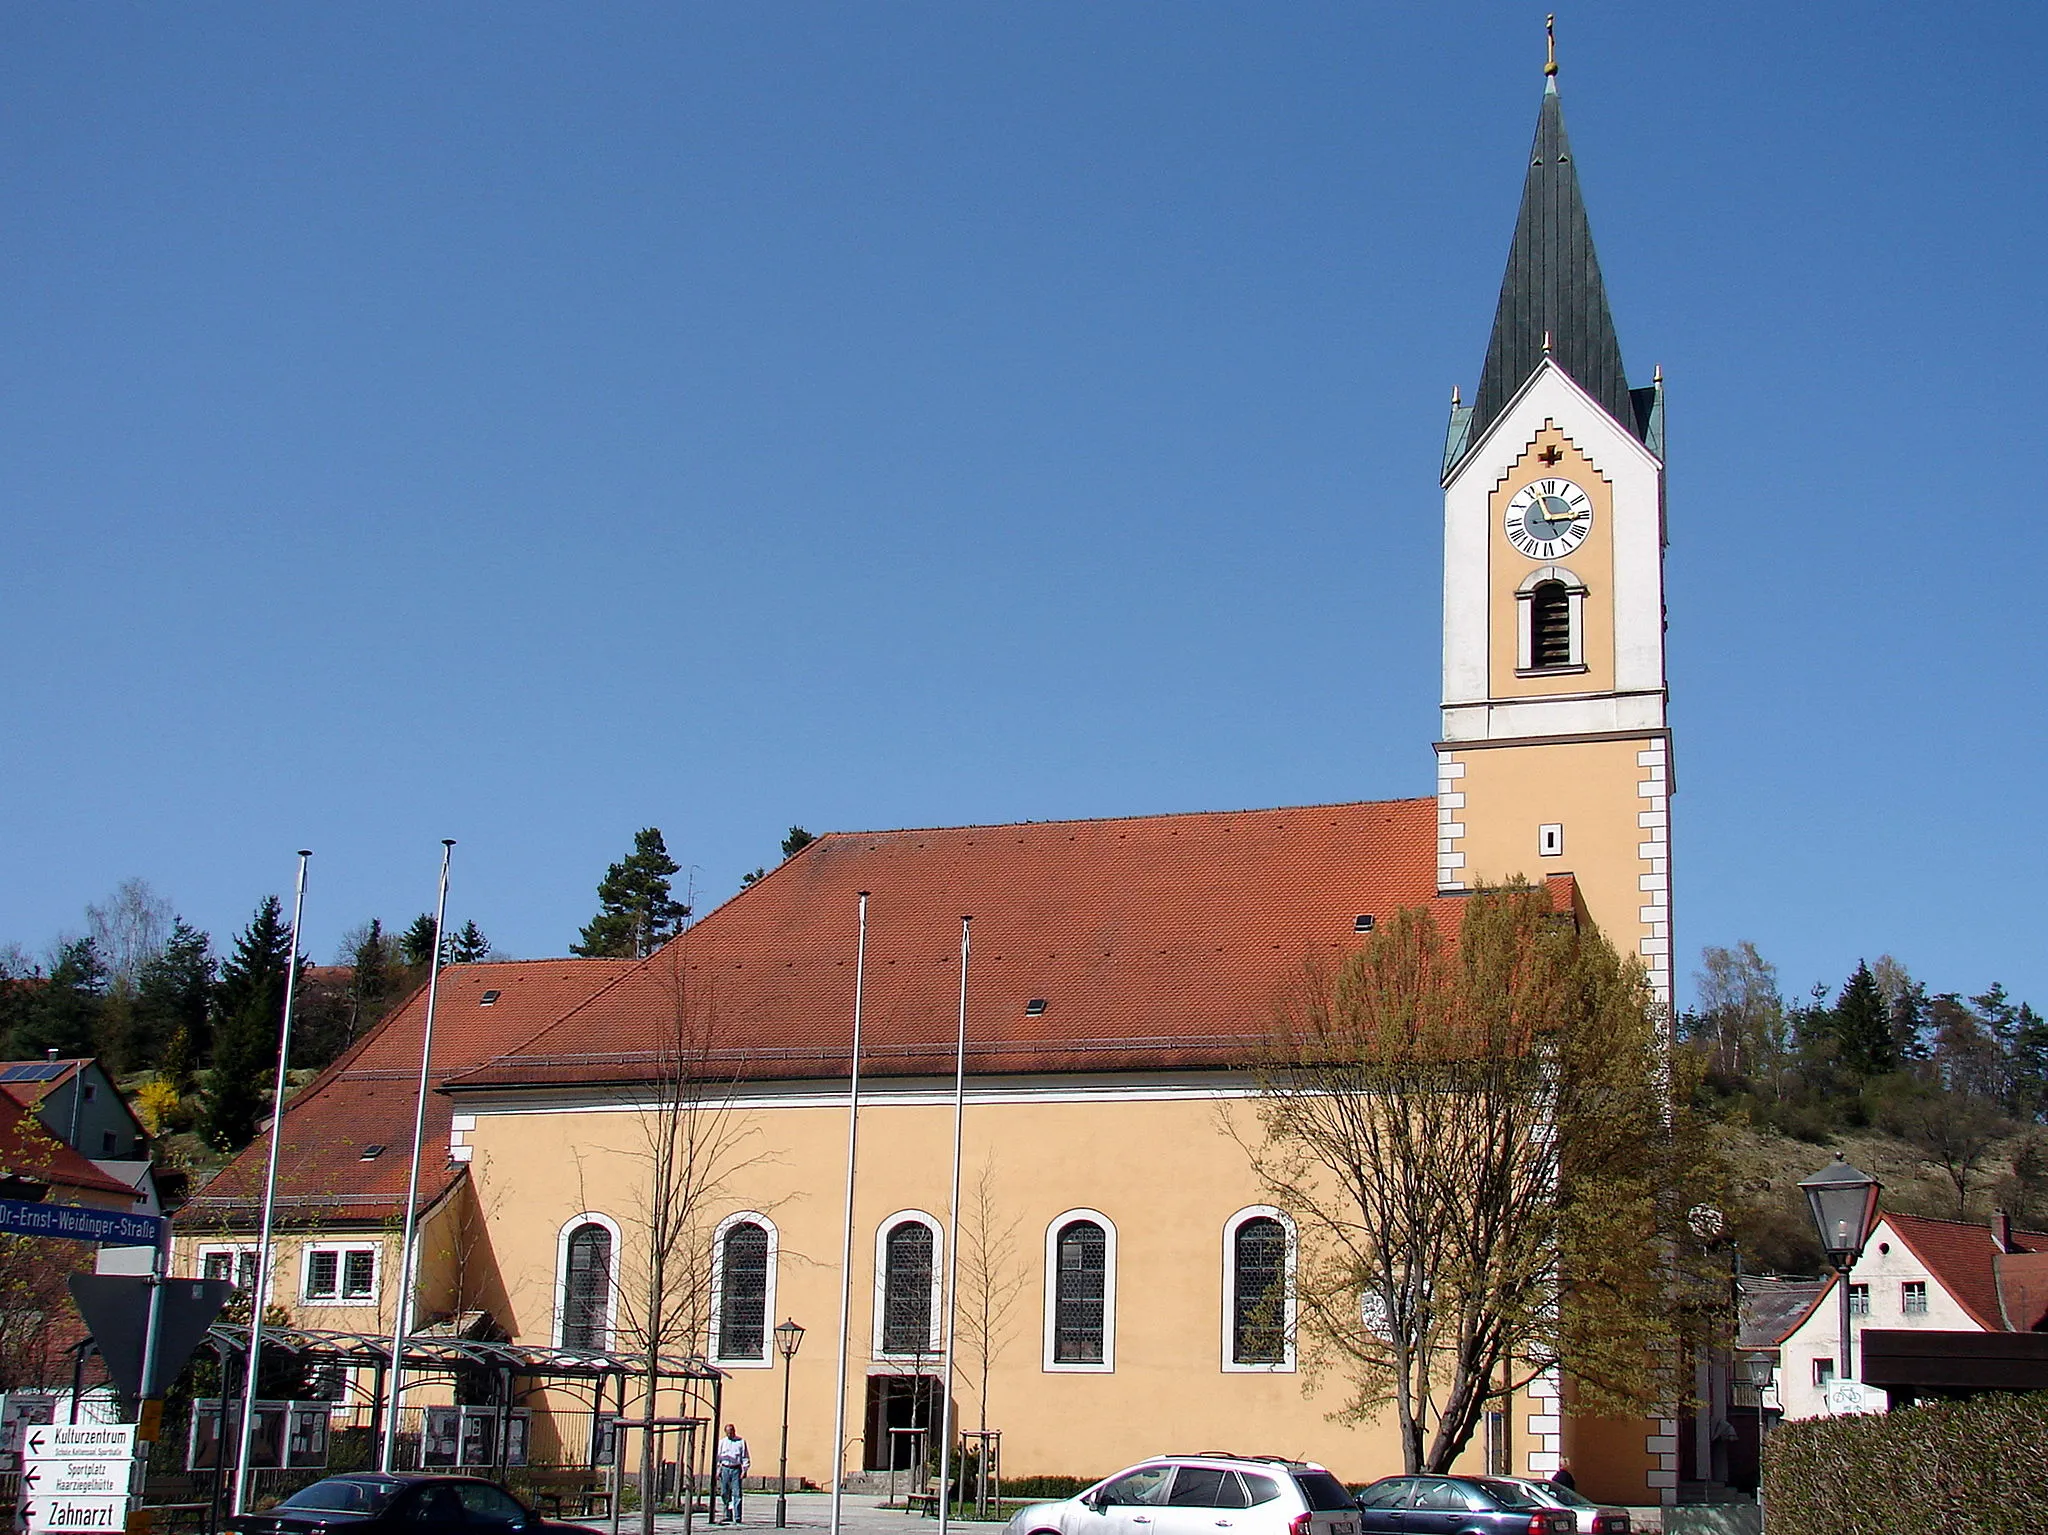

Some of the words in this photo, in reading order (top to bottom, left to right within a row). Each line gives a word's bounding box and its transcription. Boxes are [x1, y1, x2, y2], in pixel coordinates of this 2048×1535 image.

[0, 1204, 156, 1239] Dr.-Ernst-Weidinger-Straße
[54, 1427, 127, 1444] Kulturzentrum
[67, 1463, 106, 1478] Sportplatz
[56, 1478, 114, 1493] Haarziegelhütte
[48, 1502, 114, 1526] Zahnarzt
